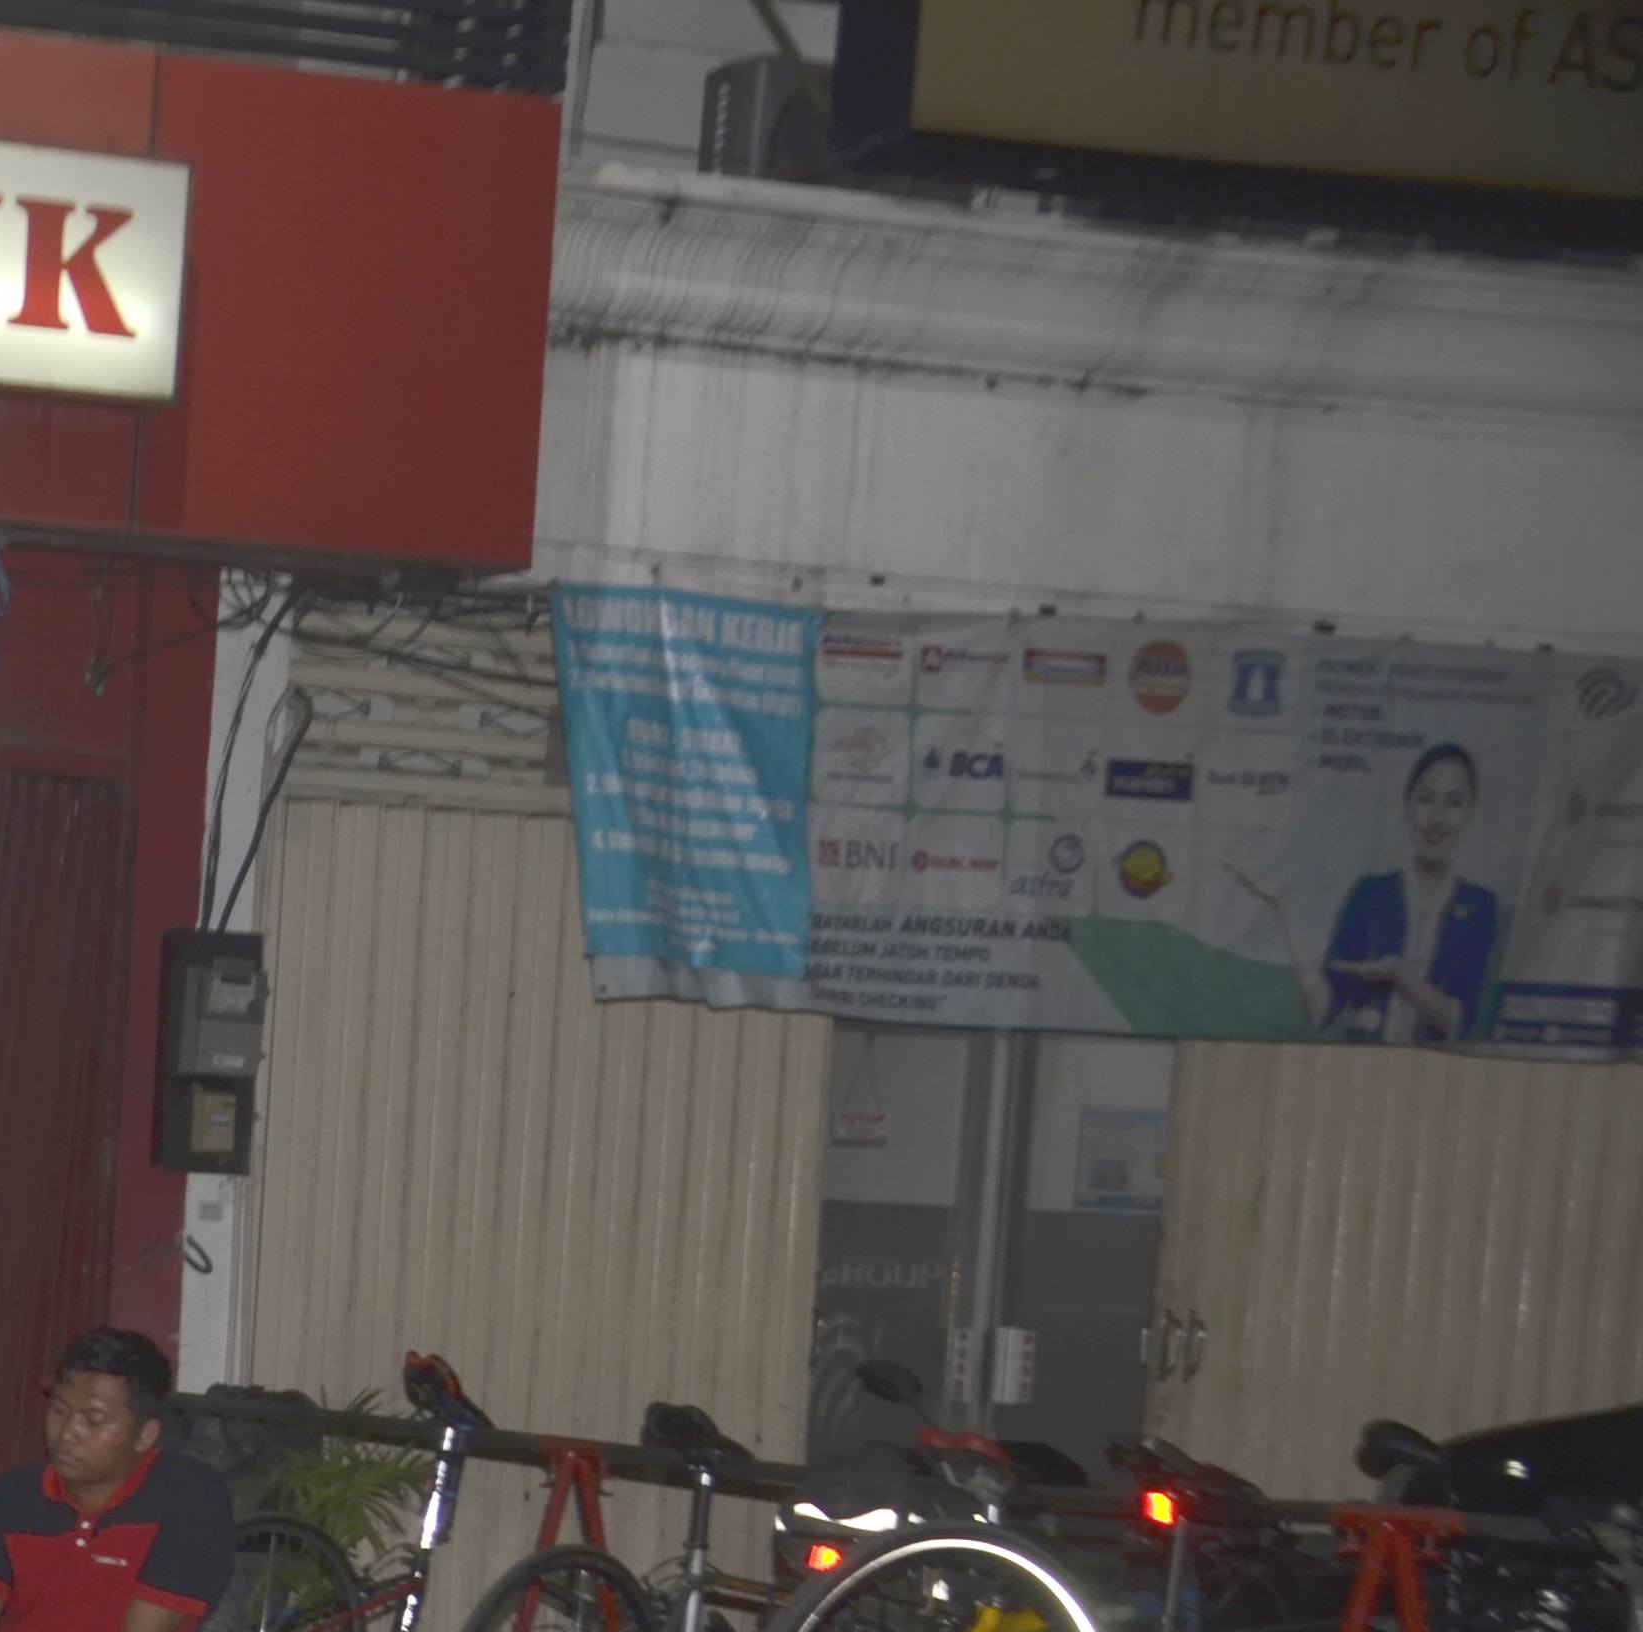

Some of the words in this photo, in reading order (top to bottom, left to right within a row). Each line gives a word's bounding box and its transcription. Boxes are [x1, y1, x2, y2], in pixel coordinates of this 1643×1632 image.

[949, 750, 1004, 780] BCA
[844, 840, 898, 871] BNI
[899, 916, 1017, 940] ANGSURAN
